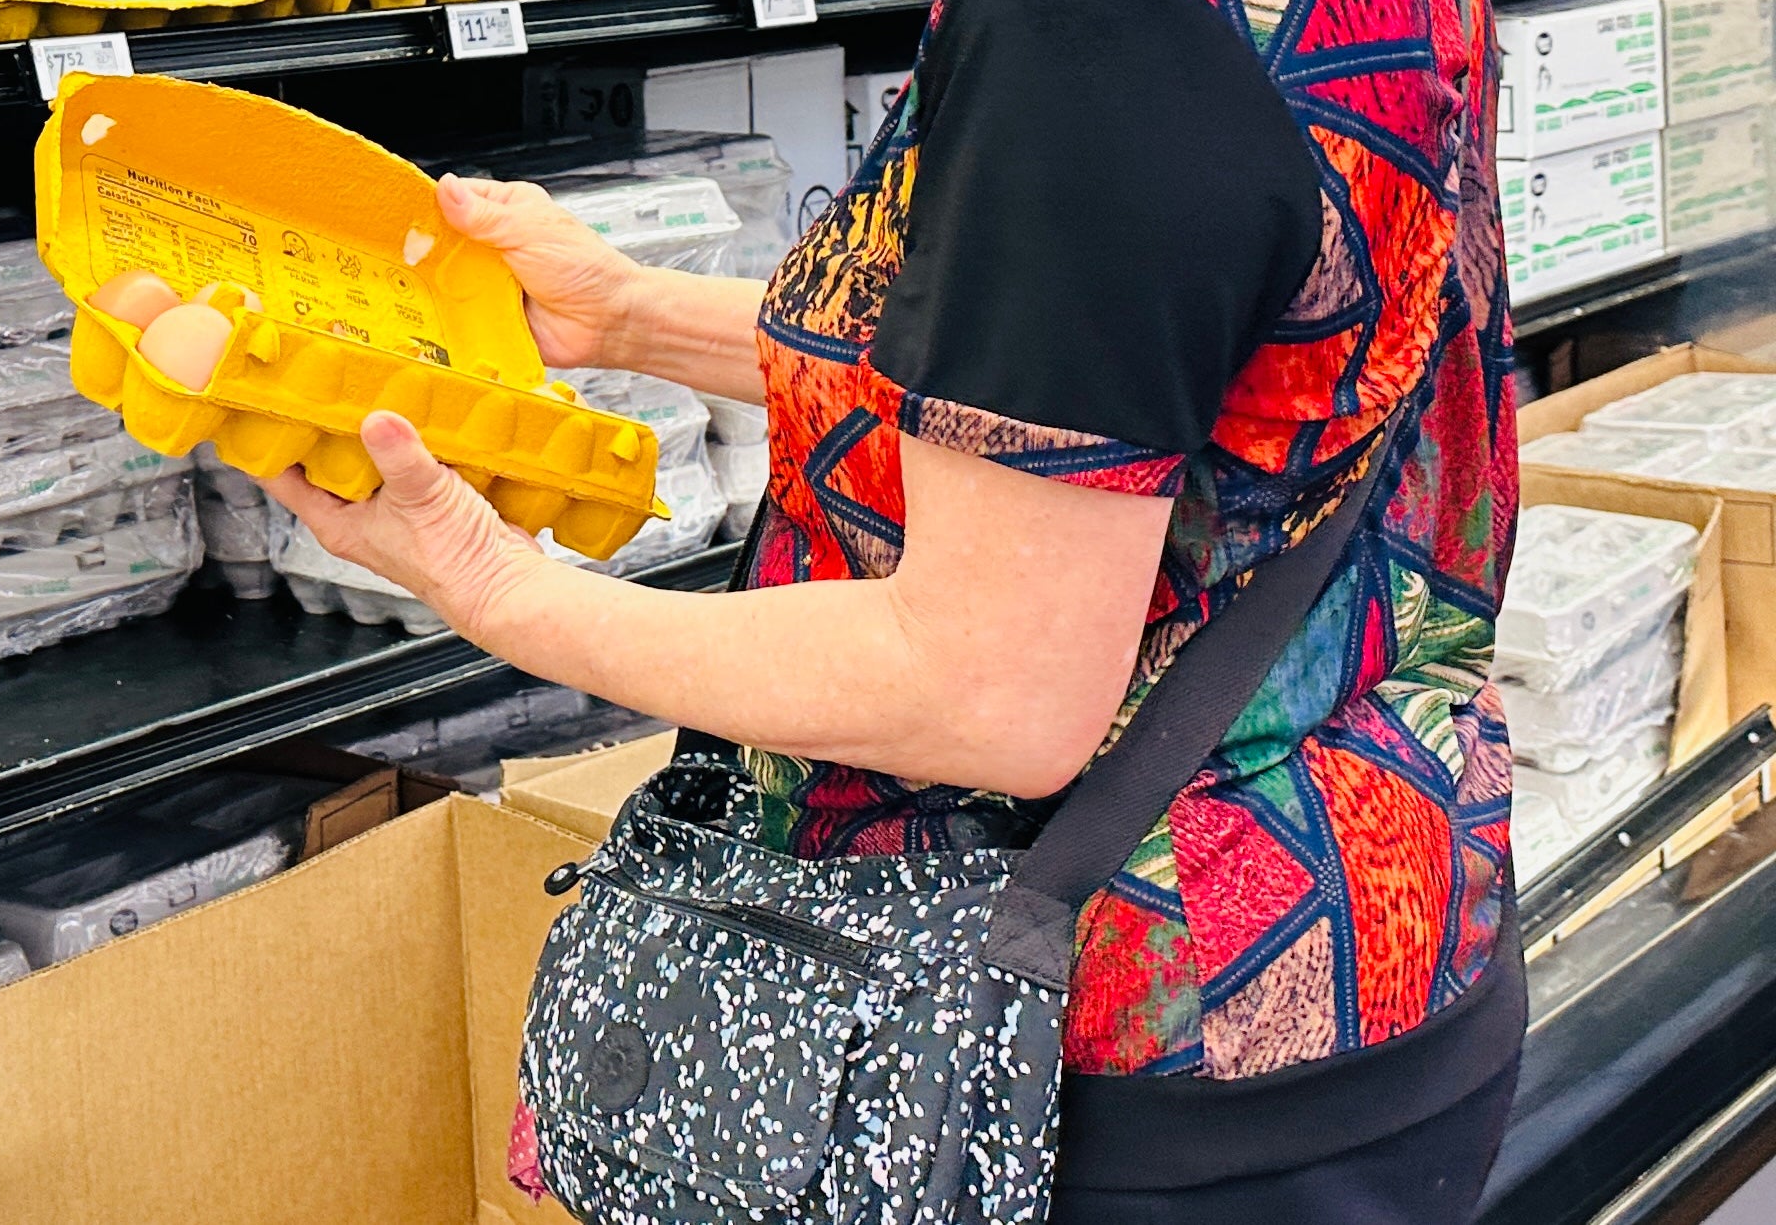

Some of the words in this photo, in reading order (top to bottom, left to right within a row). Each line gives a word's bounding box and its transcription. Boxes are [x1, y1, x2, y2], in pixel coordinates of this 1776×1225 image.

[97, 186, 142, 206] Calories
[128, 169, 183, 196] Nutrition
[186, 190, 221, 210] Facts
[240, 231, 257, 246] 70
